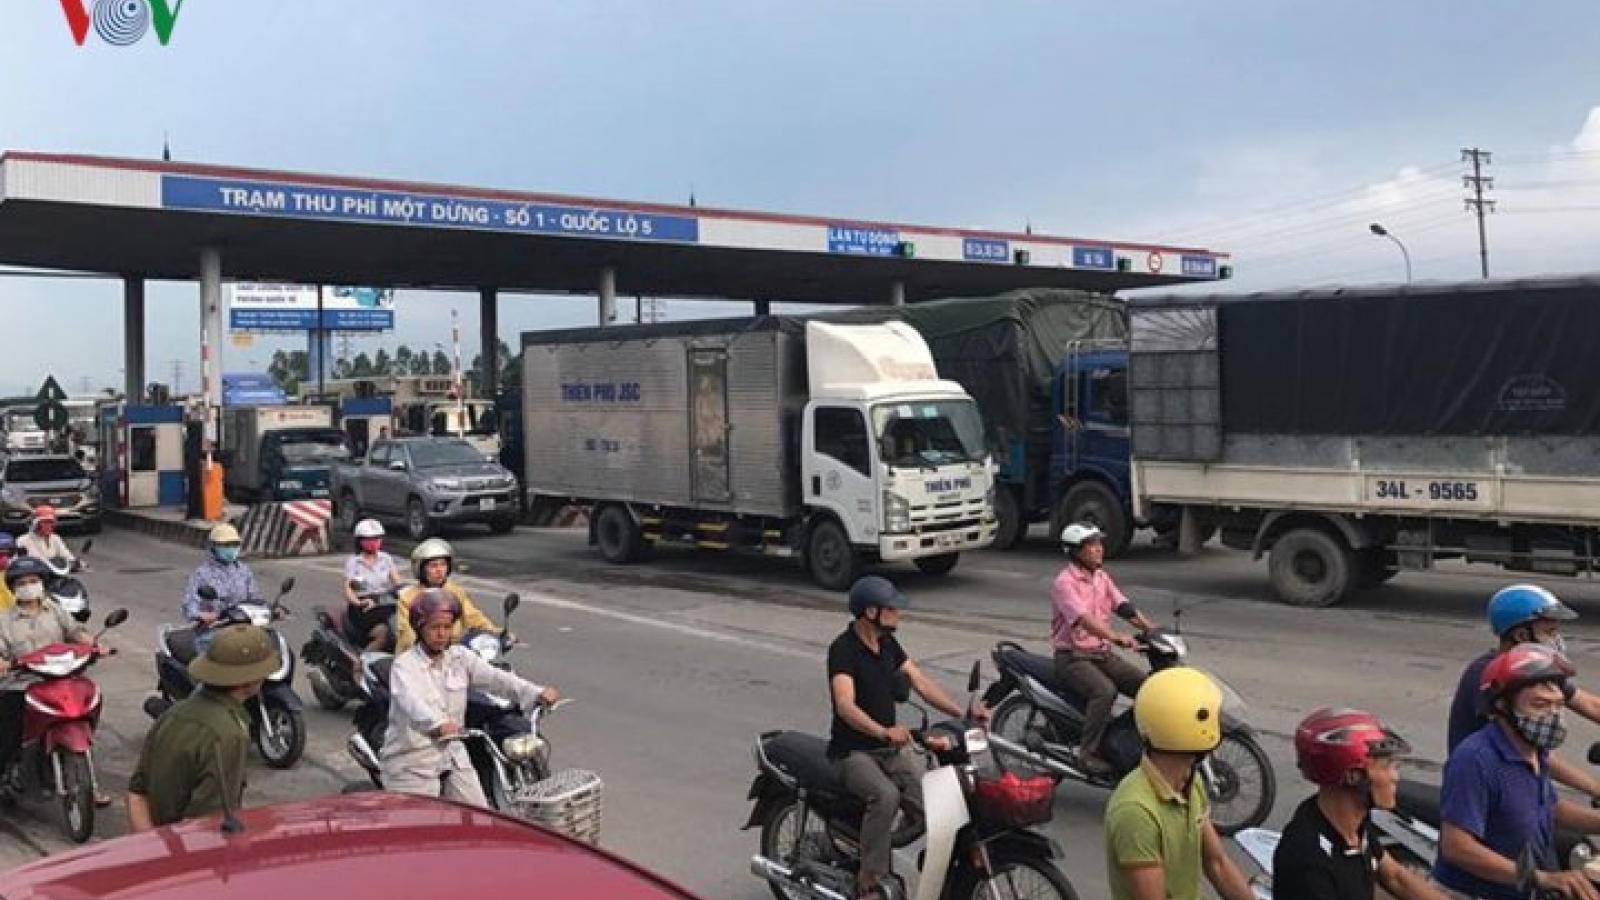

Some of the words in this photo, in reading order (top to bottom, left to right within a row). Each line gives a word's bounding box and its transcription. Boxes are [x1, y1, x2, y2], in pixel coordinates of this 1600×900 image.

[219, 187, 285, 213] TRẠM
[291, 193, 337, 212] THU
[343, 193, 377, 216] PHÍ
[383, 197, 426, 223] MỘT
[431, 201, 489, 224] DỪNG
[504, 203, 530, 226] SỐ
[535, 211, 544, 228] 1
[560, 210, 610, 232] QUỐC
[616, 214, 639, 239] LỘ
[641, 220, 652, 235] 5
[1376, 480, 1411, 500] 34L
[1428, 481, 1478, 501] 9565
